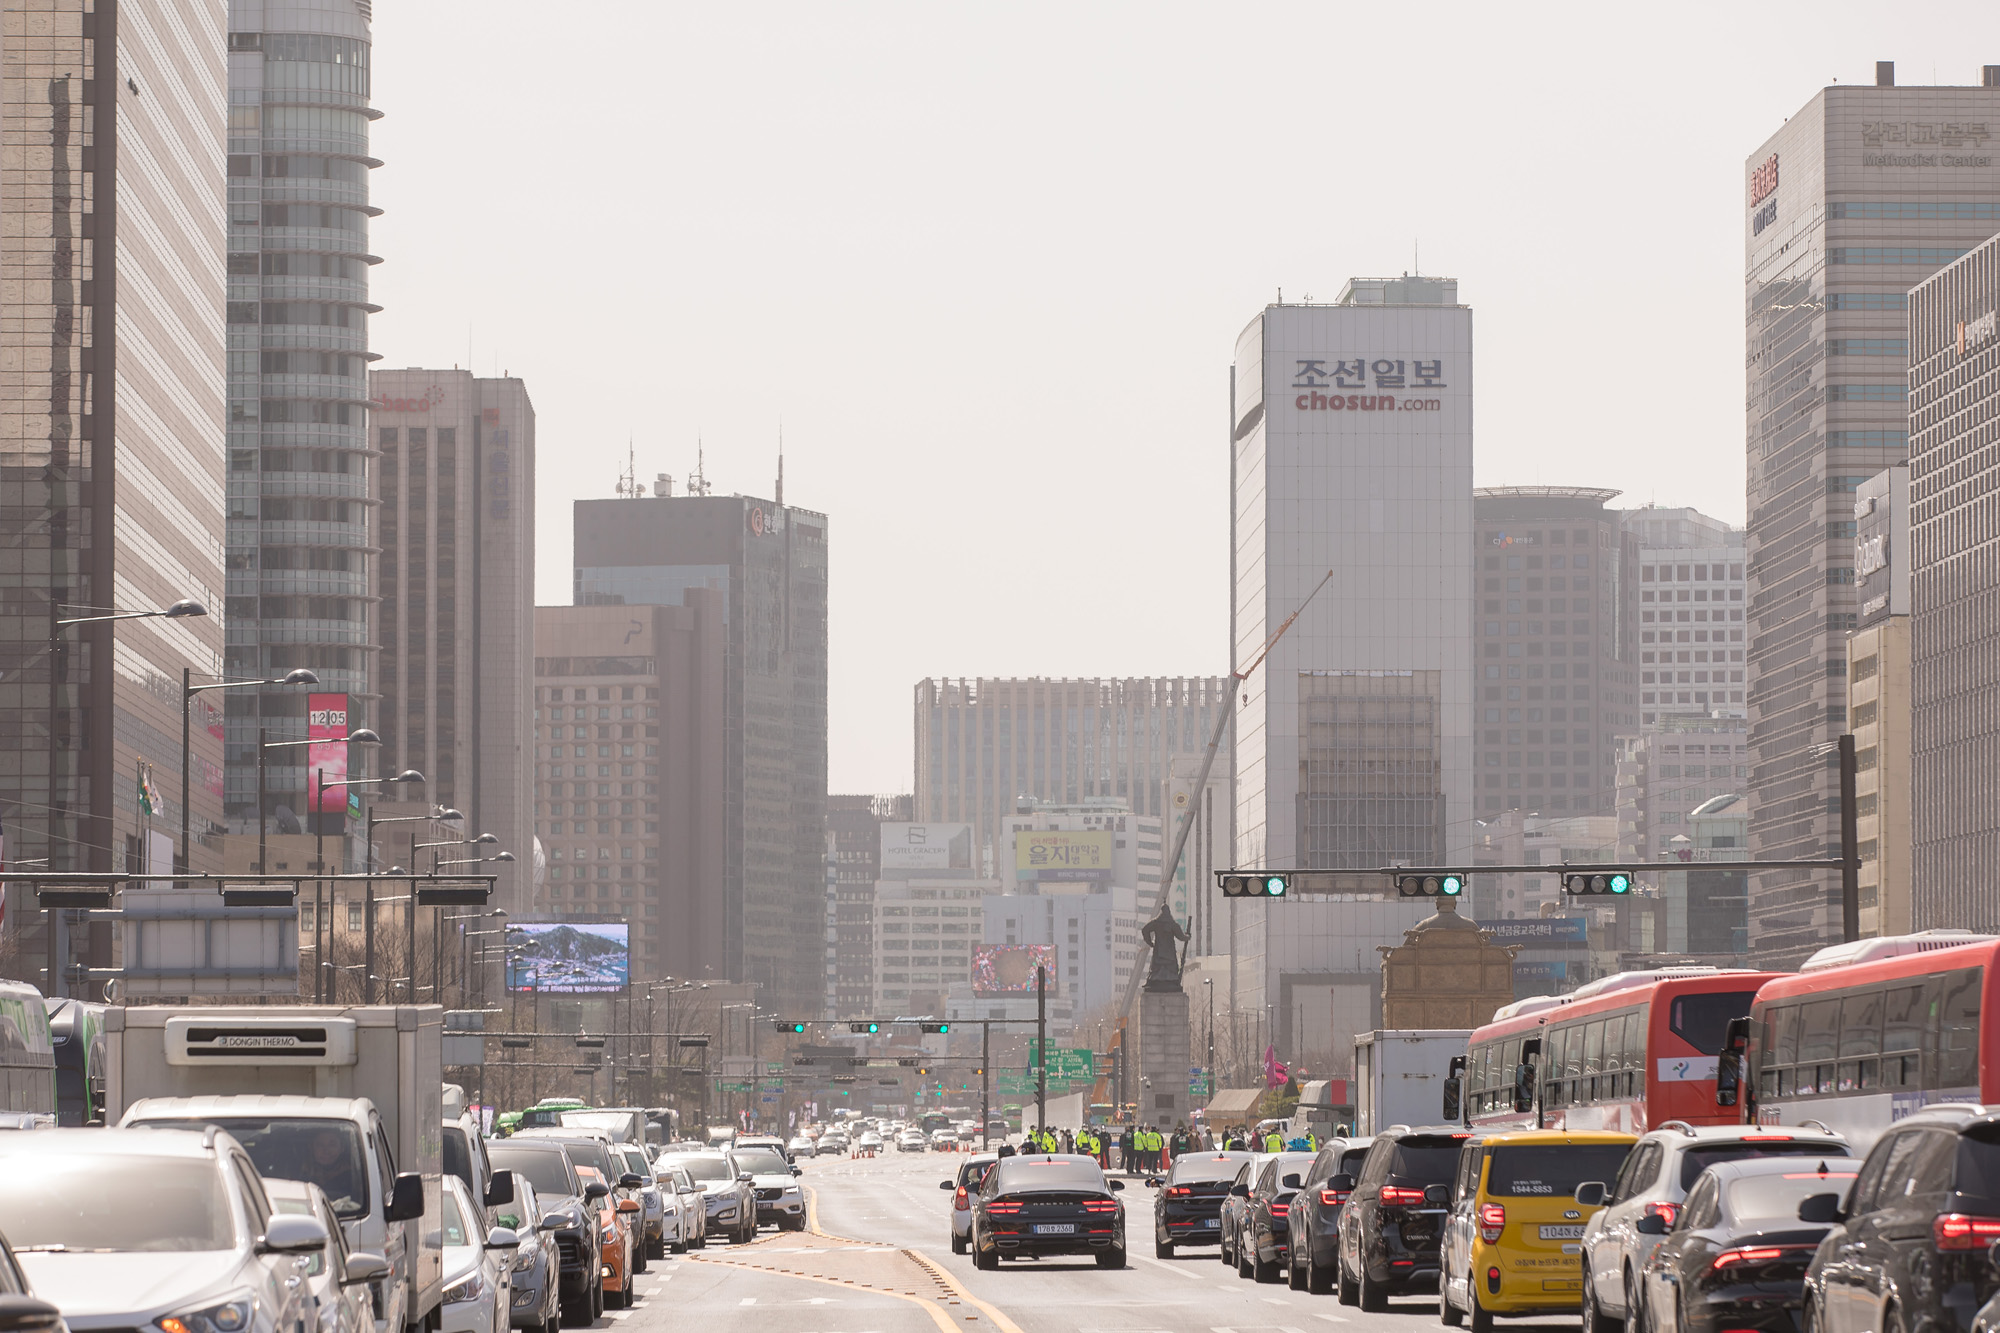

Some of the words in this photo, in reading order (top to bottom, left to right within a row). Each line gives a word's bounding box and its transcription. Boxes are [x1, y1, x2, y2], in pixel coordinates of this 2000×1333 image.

[1862, 121, 1991, 147] 감리교본부
[1864, 153, 1937, 167] Methodist
[1942, 153, 1992, 167] Center
[1292, 359, 1447, 388] 조선일보
[371, 393, 430, 412] baco
[1296, 391, 1441, 411] chosun.com
[229, 1037, 261, 1047] DONGIN
[263, 1037, 295, 1047] THERMO
